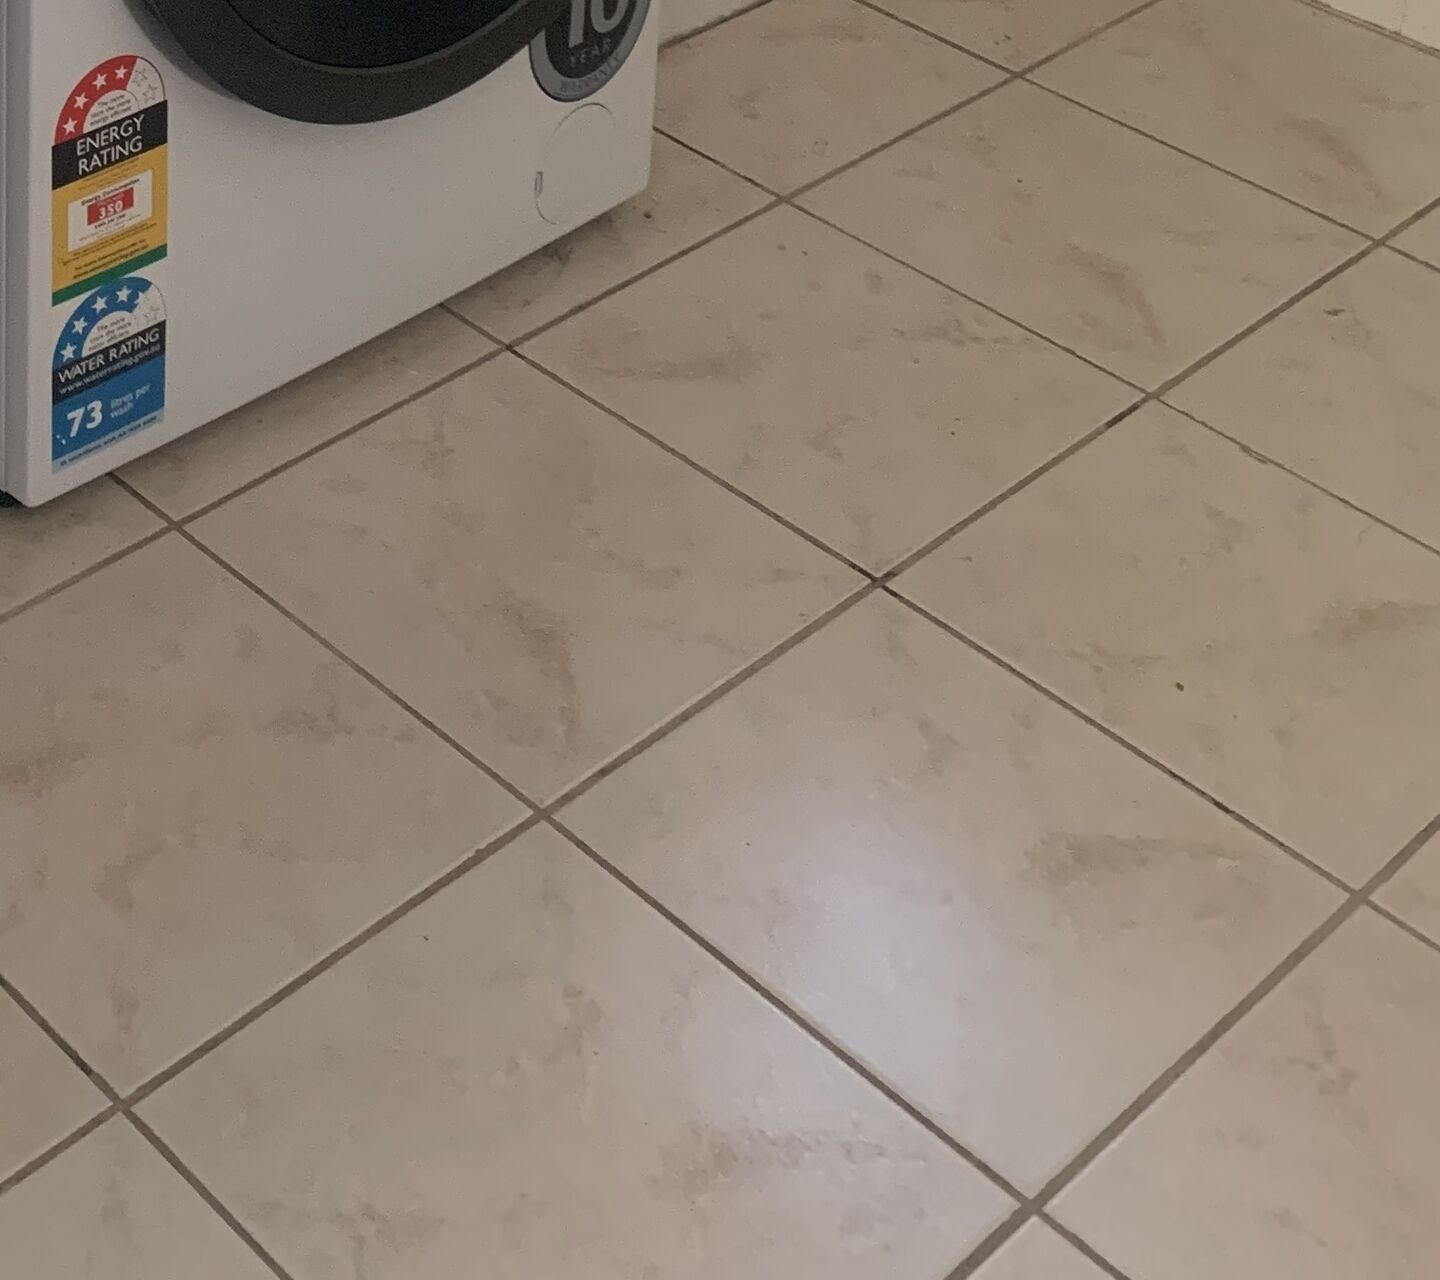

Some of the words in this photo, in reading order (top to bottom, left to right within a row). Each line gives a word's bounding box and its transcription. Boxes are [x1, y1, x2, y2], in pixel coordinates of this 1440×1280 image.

[76, 114, 145, 156] ENERGY
[78, 136, 143, 176] RATING
[98, 199, 124, 221] 350
[58, 354, 106, 383] WATER
[109, 328, 160, 362] RATING
[110, 402, 134, 418] wash
[135, 384, 150, 400] per
[66, 400, 103, 438] 73
